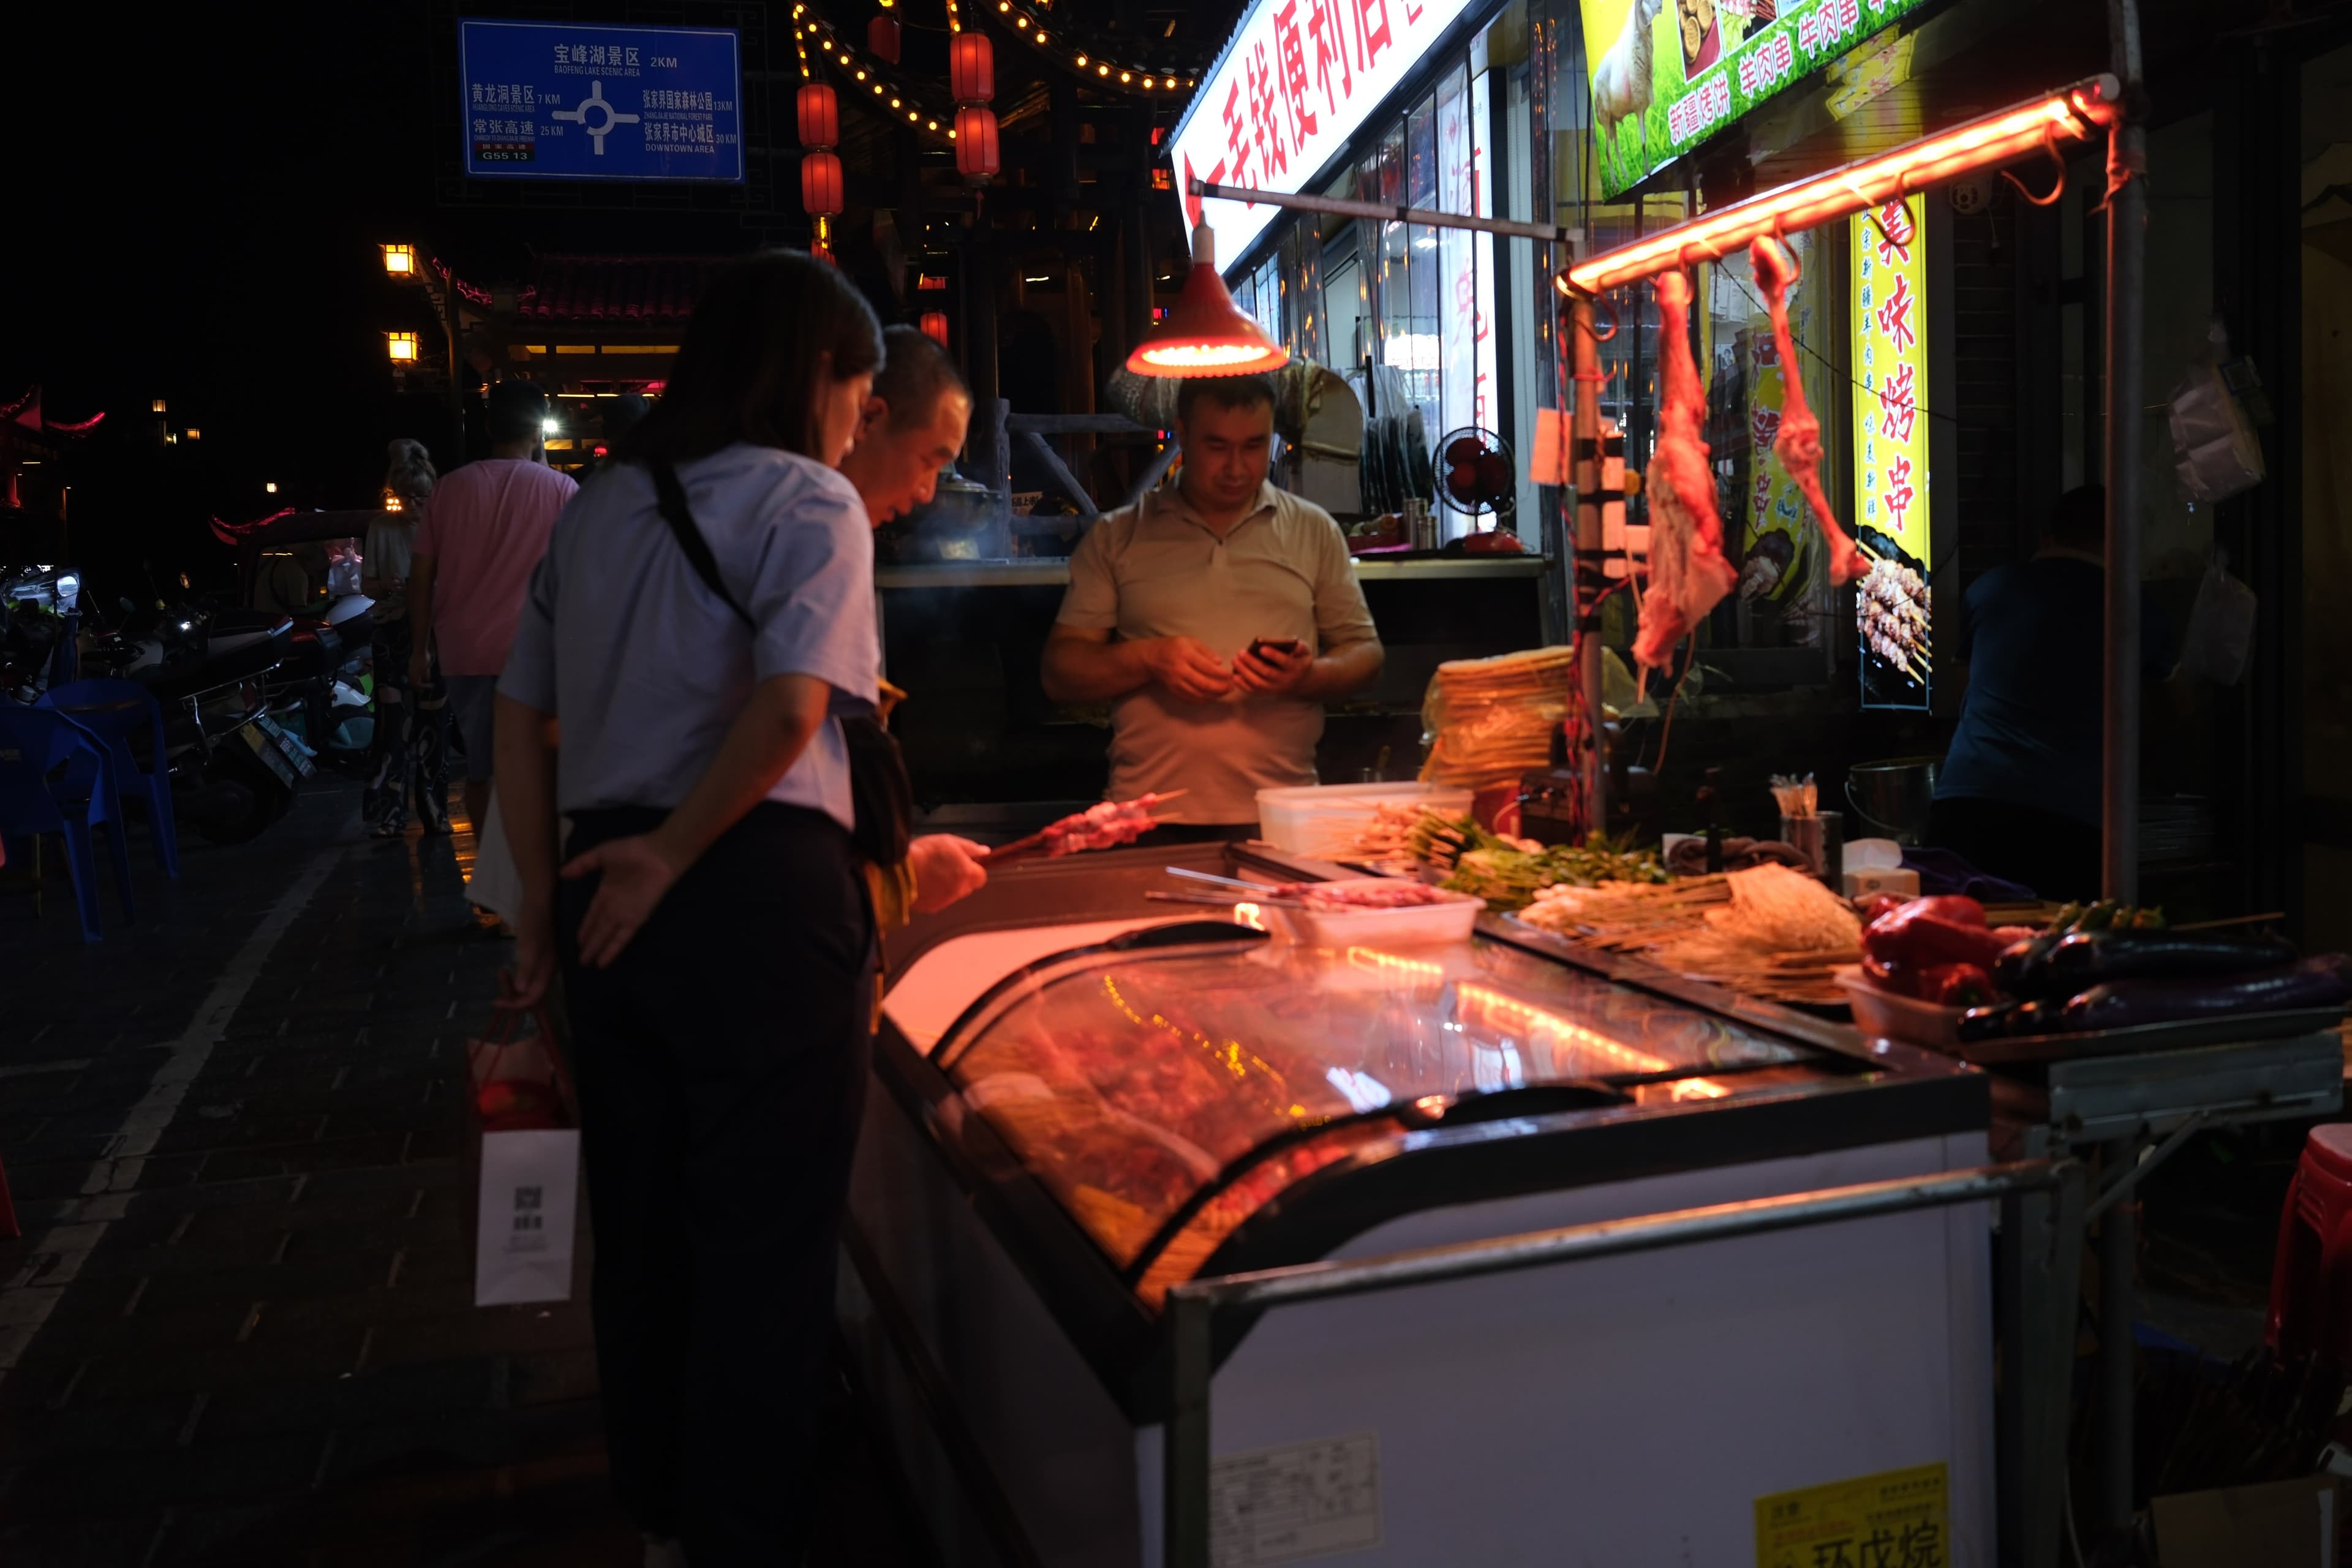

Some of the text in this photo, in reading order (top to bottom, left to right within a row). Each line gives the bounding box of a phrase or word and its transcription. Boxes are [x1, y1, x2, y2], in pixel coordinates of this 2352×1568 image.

[554, 44, 640, 66] 宝峰湖景区
[650, 56, 677, 68] 2KM
[554, 64, 640, 77] BAOFENG LAKE SCENIC AREA
[1670, 70, 1730, 145] 新疆烤饼
[1740, 32, 1792, 97] 羊肉串
[1798, 0, 1860, 59] 牛肉串
[472, 83, 535, 104] 黄龙洞景区
[537, 94, 560, 105] 7 KM
[643, 89, 713, 110] 张家界国家森林公园
[473, 118, 535, 135] 常张高速
[540, 125, 564, 136] 25 KM
[644, 122, 714, 143] 张家界市中心城区
[715, 134, 737, 145] 30 KM
[645, 143, 715, 154] DOWNTOWN AREA
[1877, 200, 1916, 532] 美味烤串
